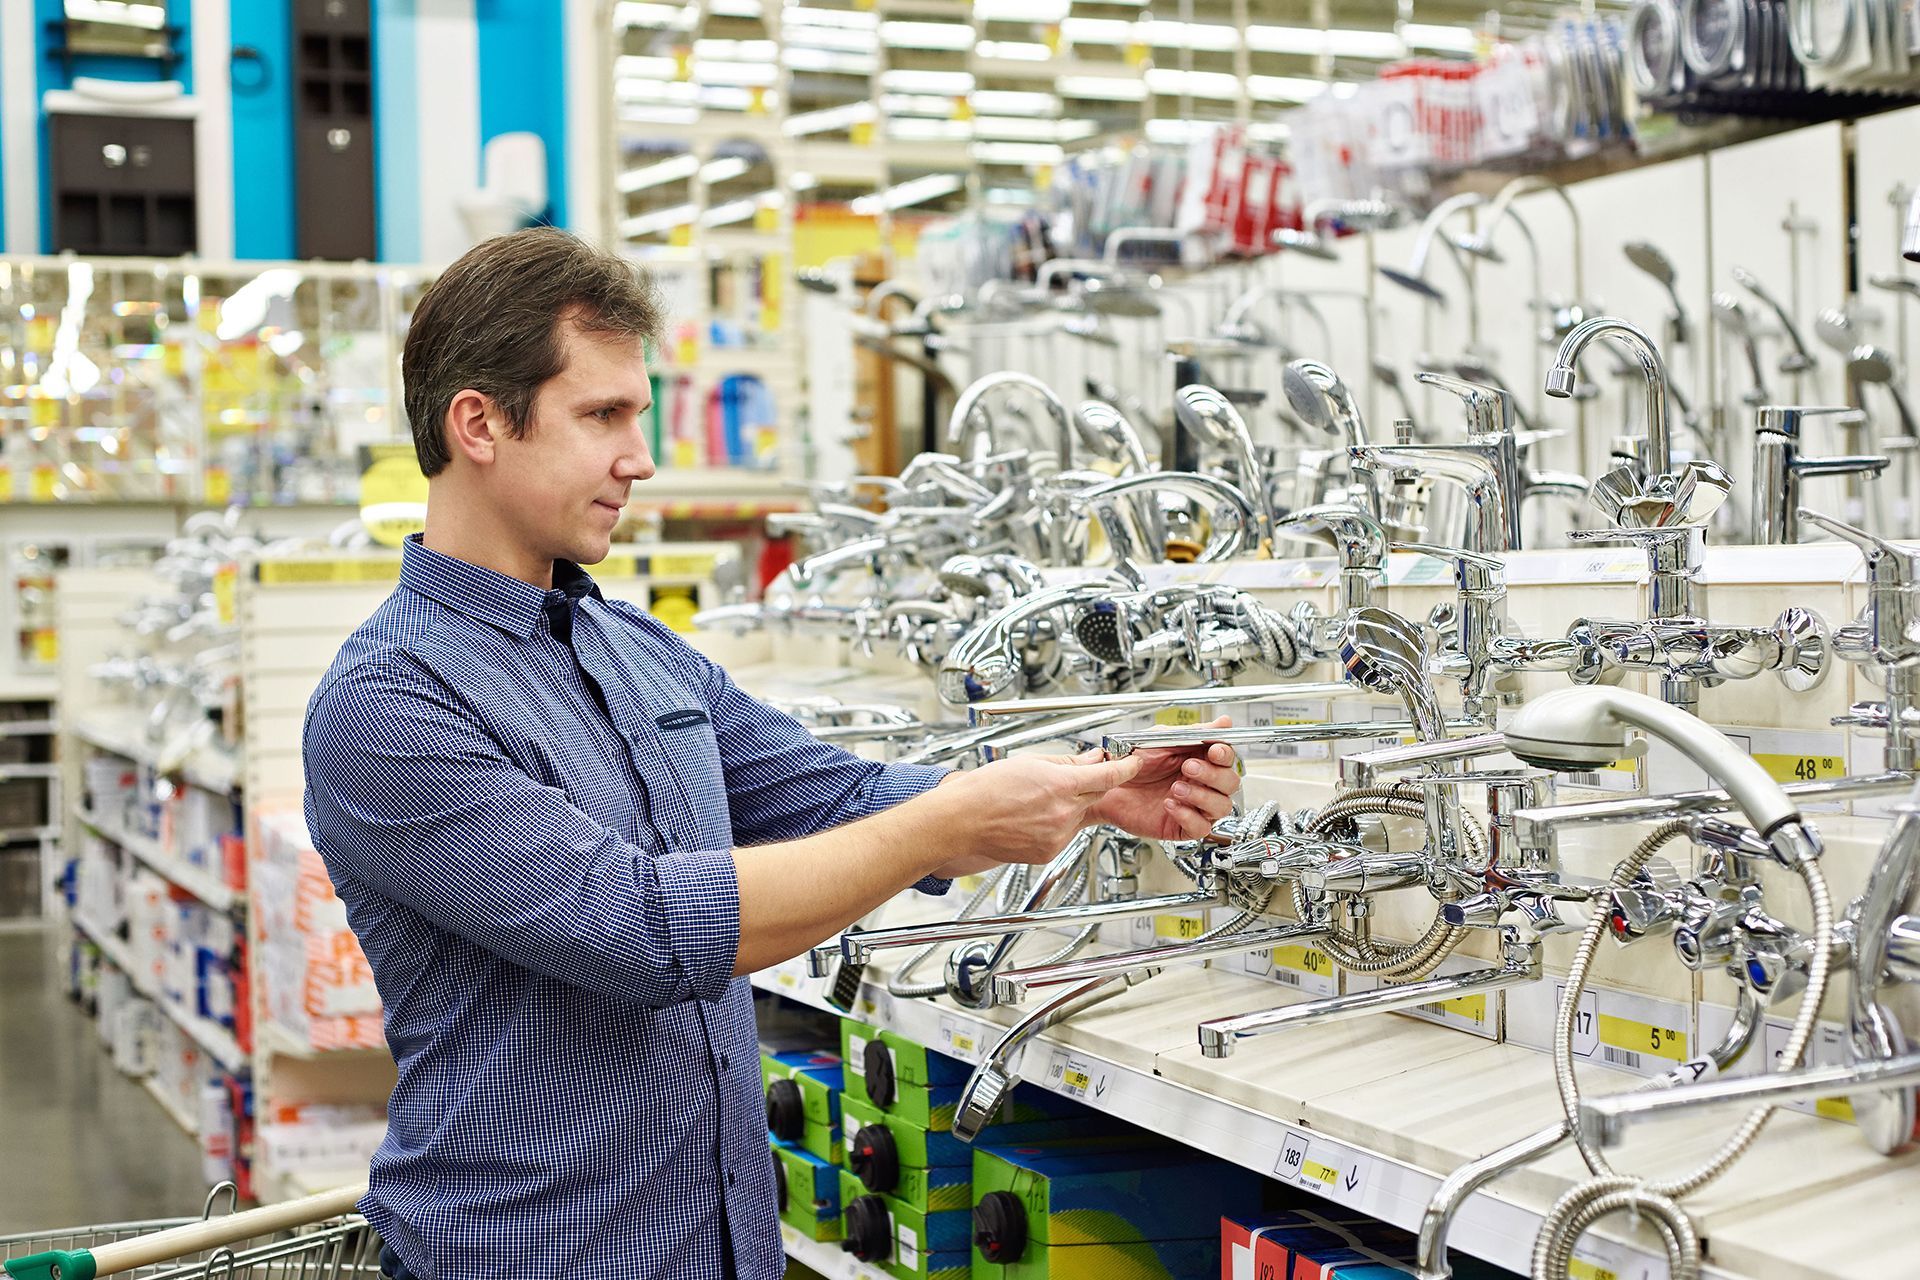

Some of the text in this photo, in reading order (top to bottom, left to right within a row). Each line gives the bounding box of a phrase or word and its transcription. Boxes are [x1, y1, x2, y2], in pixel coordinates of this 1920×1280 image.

[1795, 758, 1833, 780] 48 00
[1180, 918, 1191, 937] 87
[1303, 950, 1318, 972] 40
[1572, 1010, 1592, 1035] 17
[1651, 1027, 1676, 1050] 5 00
[1284, 1147, 1301, 1167] 183
[1319, 1167, 1331, 1181] 77
